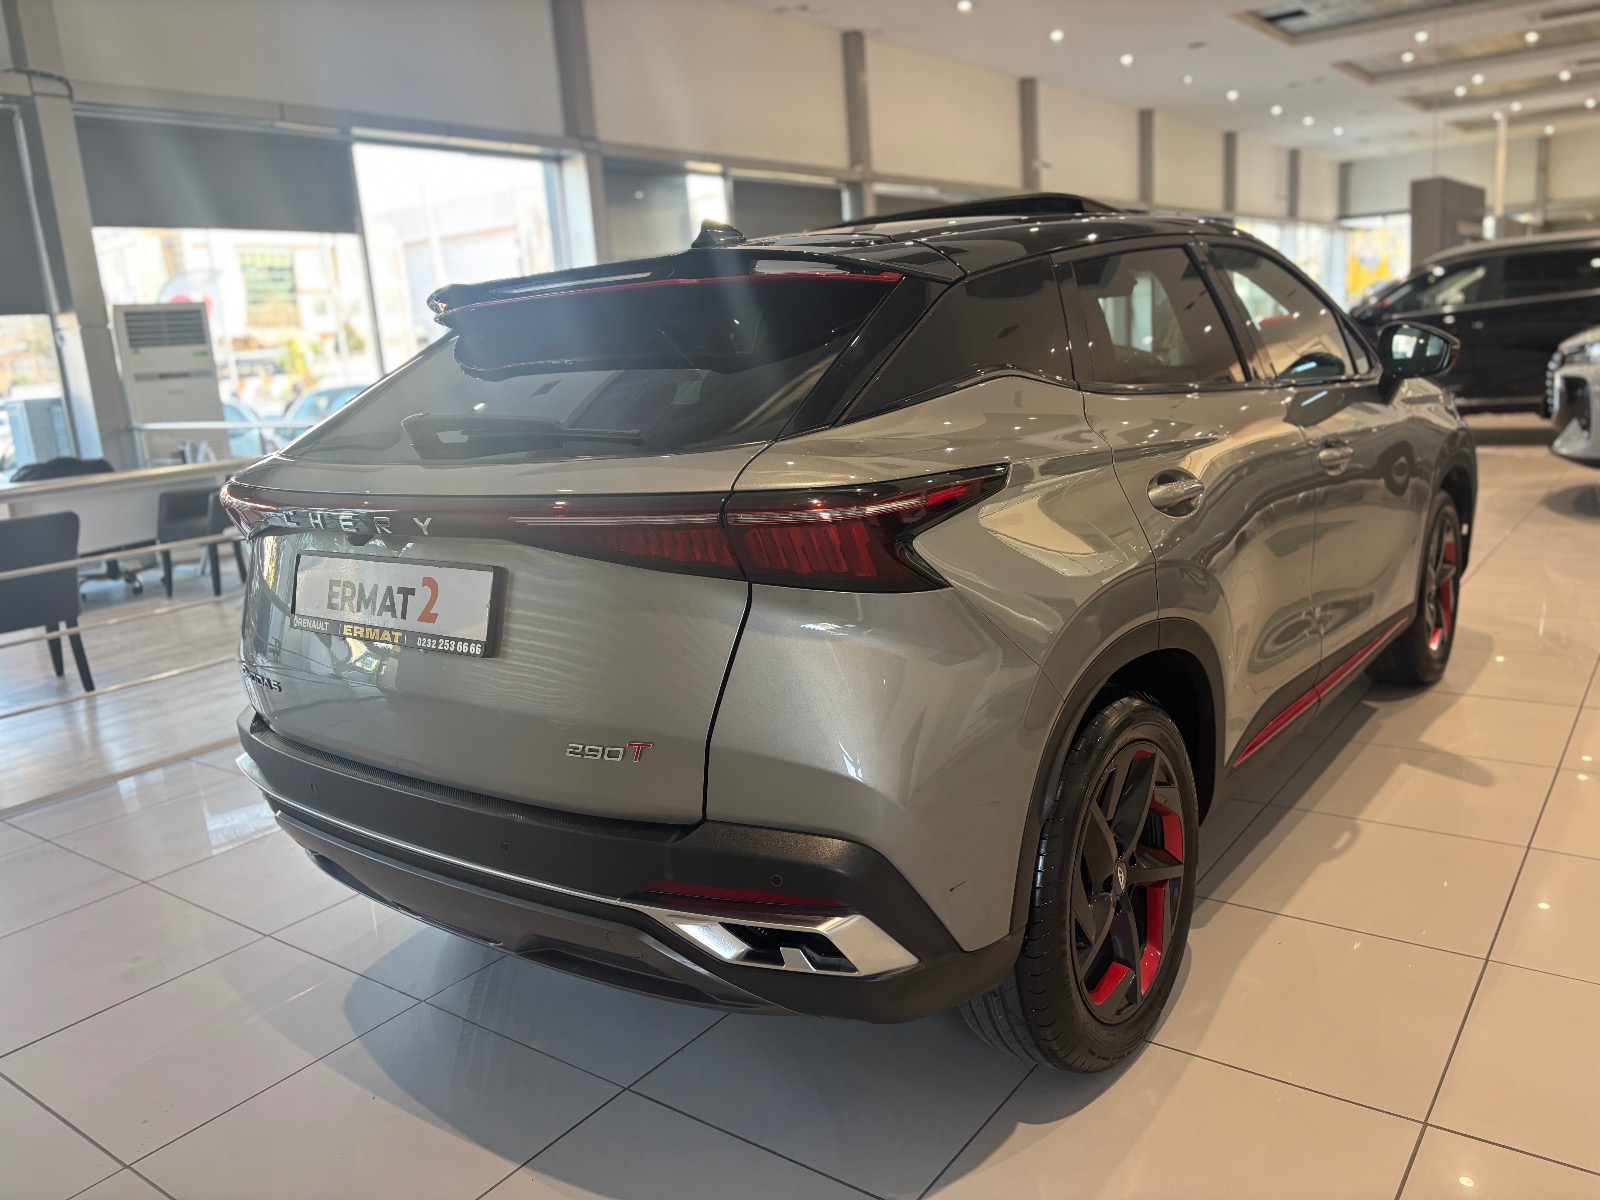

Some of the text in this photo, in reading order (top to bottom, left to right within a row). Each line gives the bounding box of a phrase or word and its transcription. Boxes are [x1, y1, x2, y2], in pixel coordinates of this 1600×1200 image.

[283, 510, 433, 536] CHERY
[327, 576, 439, 624] ERMAT 2
[297, 617, 330, 631] RENAULT
[342, 624, 403, 644] ERMAT
[416, 636, 437, 649] 0232
[438, 638, 456, 652] 253
[565, 741, 654, 763] 290T
